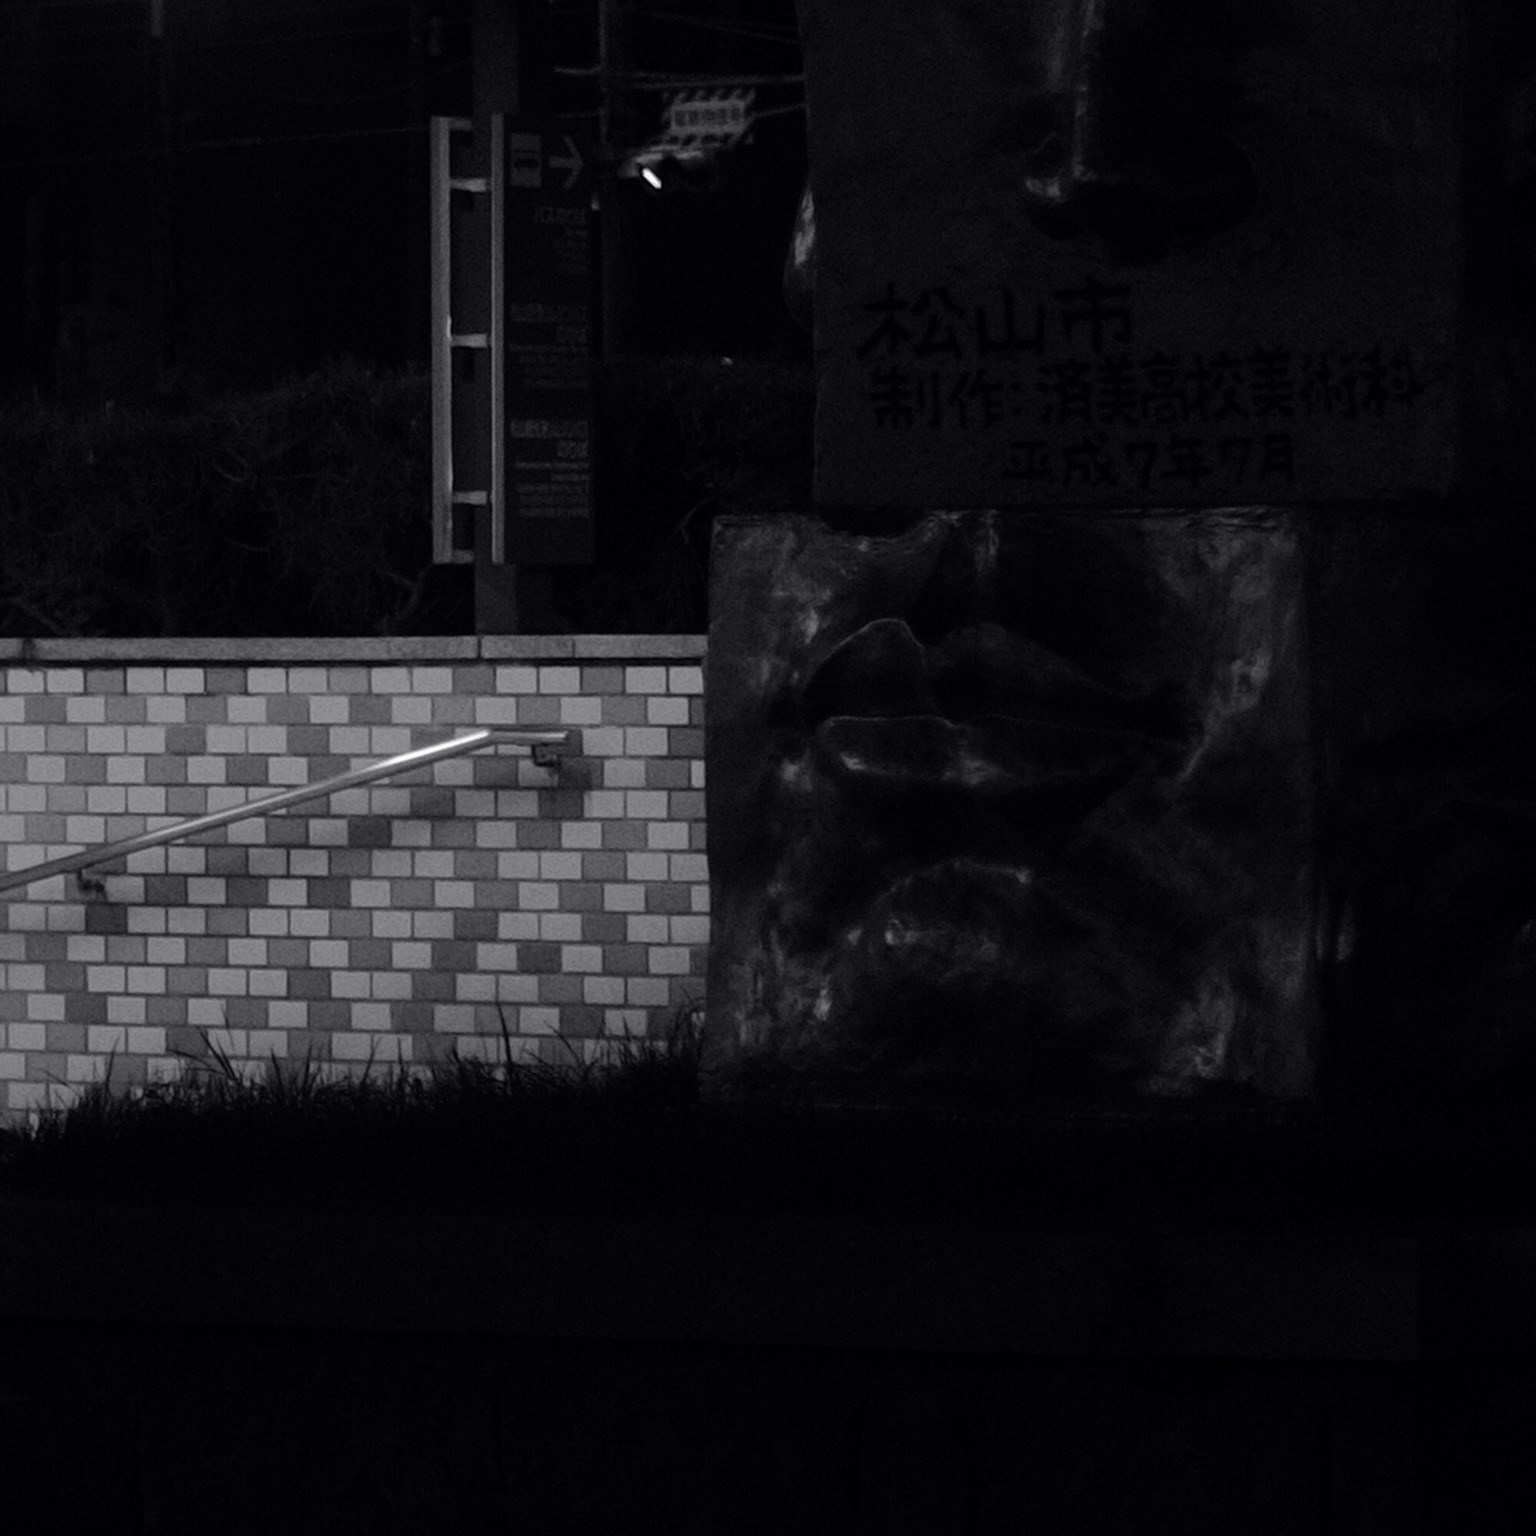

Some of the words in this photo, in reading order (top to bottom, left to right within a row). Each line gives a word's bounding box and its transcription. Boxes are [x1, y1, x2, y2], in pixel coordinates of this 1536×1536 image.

[857, 275, 1132, 360] 松山市
[1001, 431, 1296, 489] 平成7年7月
